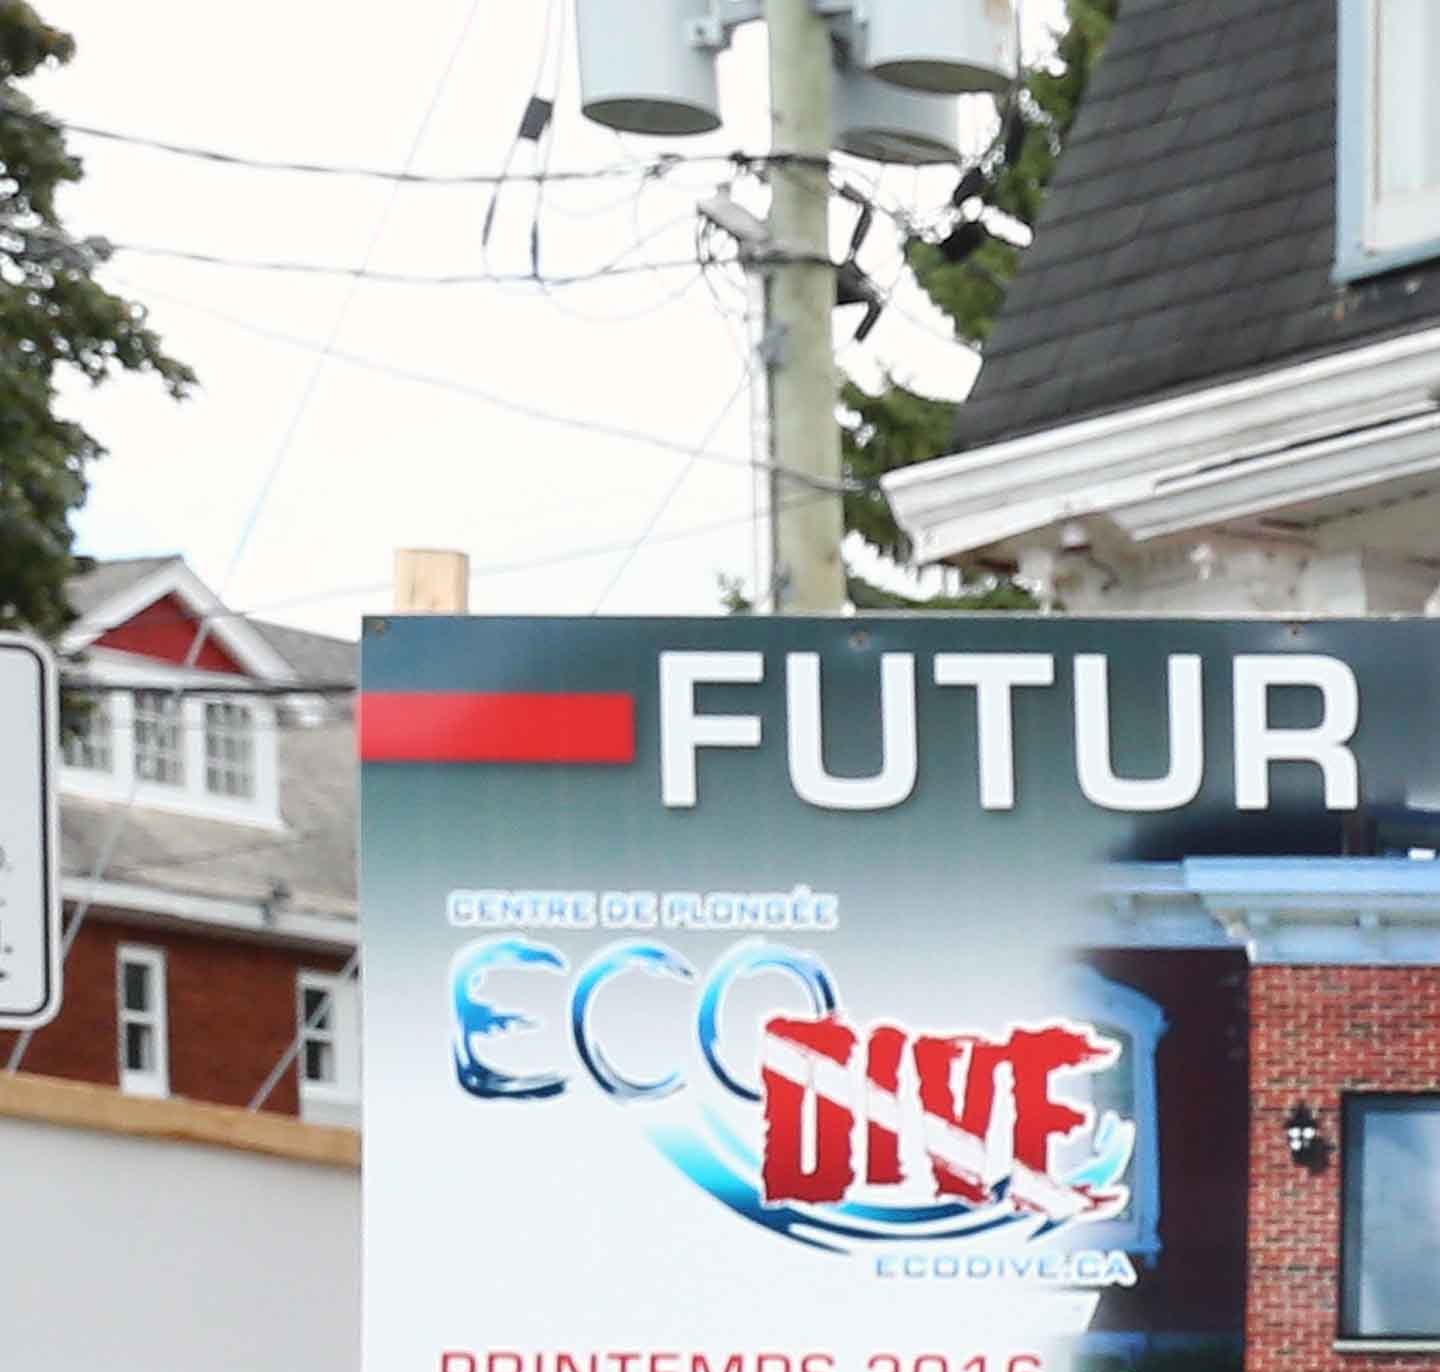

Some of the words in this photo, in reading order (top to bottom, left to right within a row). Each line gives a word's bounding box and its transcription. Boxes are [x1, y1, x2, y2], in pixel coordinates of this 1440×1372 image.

[658, 652, 1361, 813] FUTUR
[450, 893, 595, 924] CENTRE
[605, 894, 656, 925] DE
[665, 887, 834, 926] PLONGÉE
[453, 936, 837, 1101] ECO
[761, 1017, 1121, 1218] DIVE
